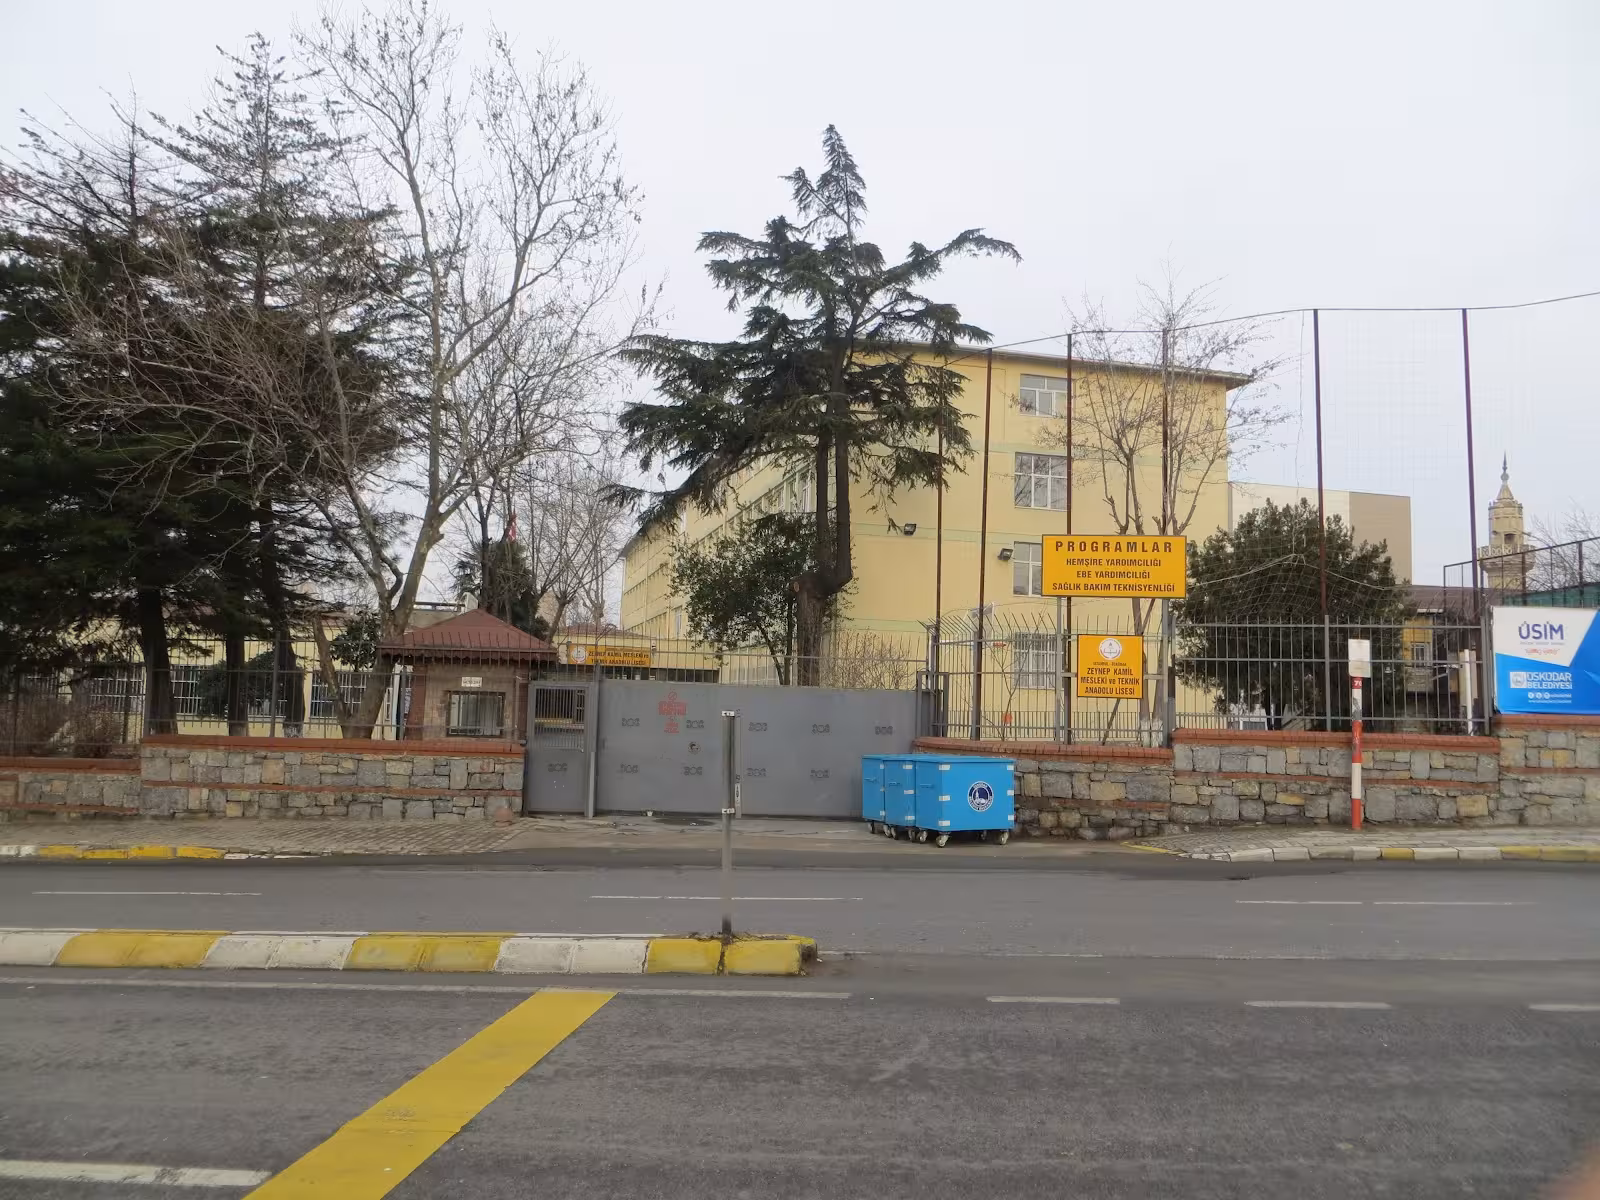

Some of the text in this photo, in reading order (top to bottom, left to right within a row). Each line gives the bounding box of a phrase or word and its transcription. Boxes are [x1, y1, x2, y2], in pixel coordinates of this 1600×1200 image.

[1055, 540, 1172, 553] PROGRAMLAR
[1066, 557, 1161, 567] HEMŞİRE YARDIMCILIĞI
[1076, 570, 1150, 579] EBE YARDIMCILIĞI
[1052, 581, 1175, 592] SAĞLIK BAKIM TEKNİSYENLİĞİ
[1087, 667, 1133, 676] ZEYNEP KAMİL
[1118, 677, 1140, 686] TEKNİK
[1085, 686, 1135, 695] ANADOLU LİSESİ
